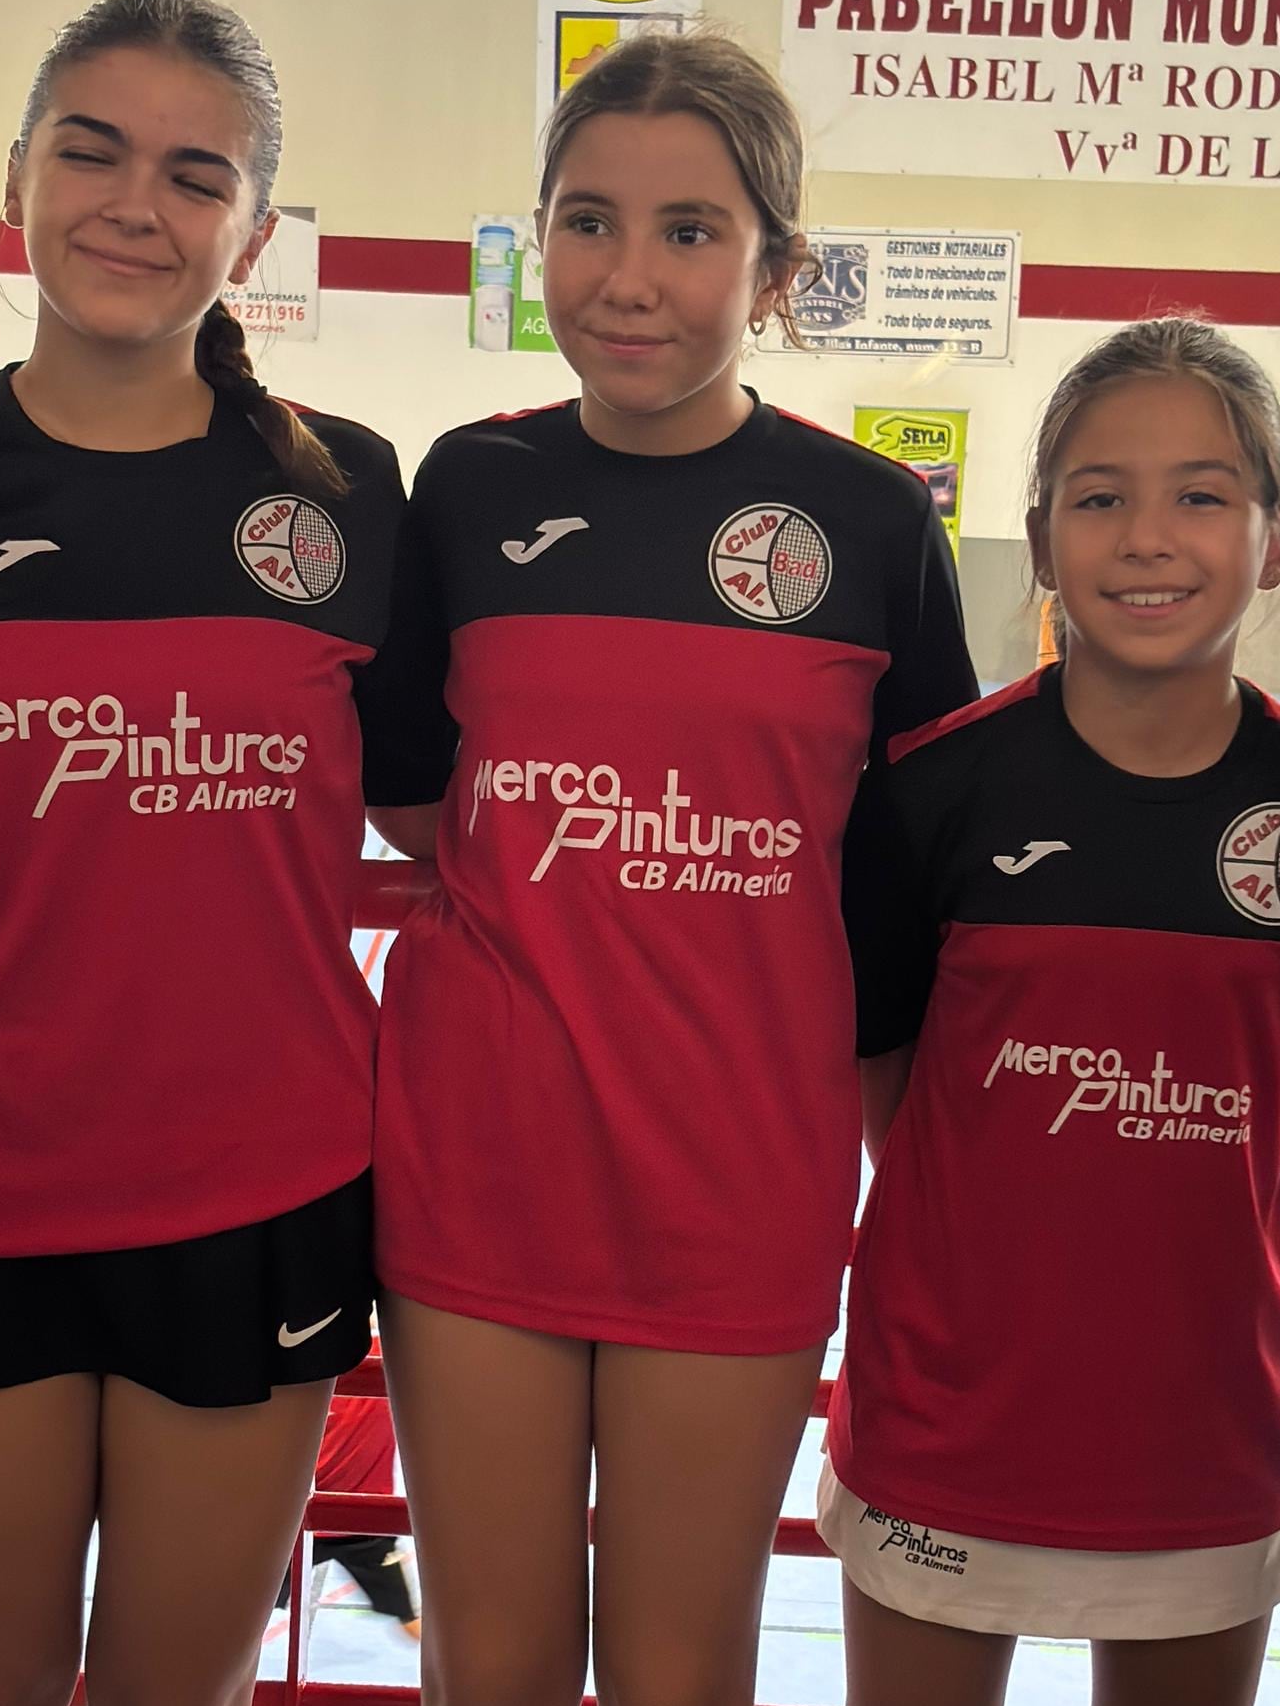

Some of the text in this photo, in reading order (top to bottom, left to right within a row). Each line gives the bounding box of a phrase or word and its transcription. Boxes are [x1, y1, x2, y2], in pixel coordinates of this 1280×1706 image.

[849, 52, 1056, 103] ISABEL
[1074, 61, 1144, 106] Mª
[1053, 129, 1138, 175] Vvª
[1155, 133, 1231, 179] DE
[886, 240, 1007, 257] GESTIONES NOTARIALES
[886, 266, 913, 279] Todo
[925, 265, 987, 281] relacionado
[987, 270, 1007, 281] con
[930, 287, 945, 300] de
[884, 314, 910, 327] Todo
[911, 313, 933, 331] tipo
[933, 316, 947, 328] de
[900, 427, 946, 445] SEYLA
[247, 503, 293, 542] Club
[725, 514, 779, 554] Club
[31, 691, 308, 819] Pinturas
[129, 784, 179, 814] CB
[529, 769, 802, 882] Pinturas
[619, 858, 792, 897] CB Almería
[1048, 1051, 1252, 1135] Pinturas
[1116, 1116, 1154, 1140] CB
[878, 1528, 969, 1563] Pinturas
[905, 1552, 920, 1565] CB
